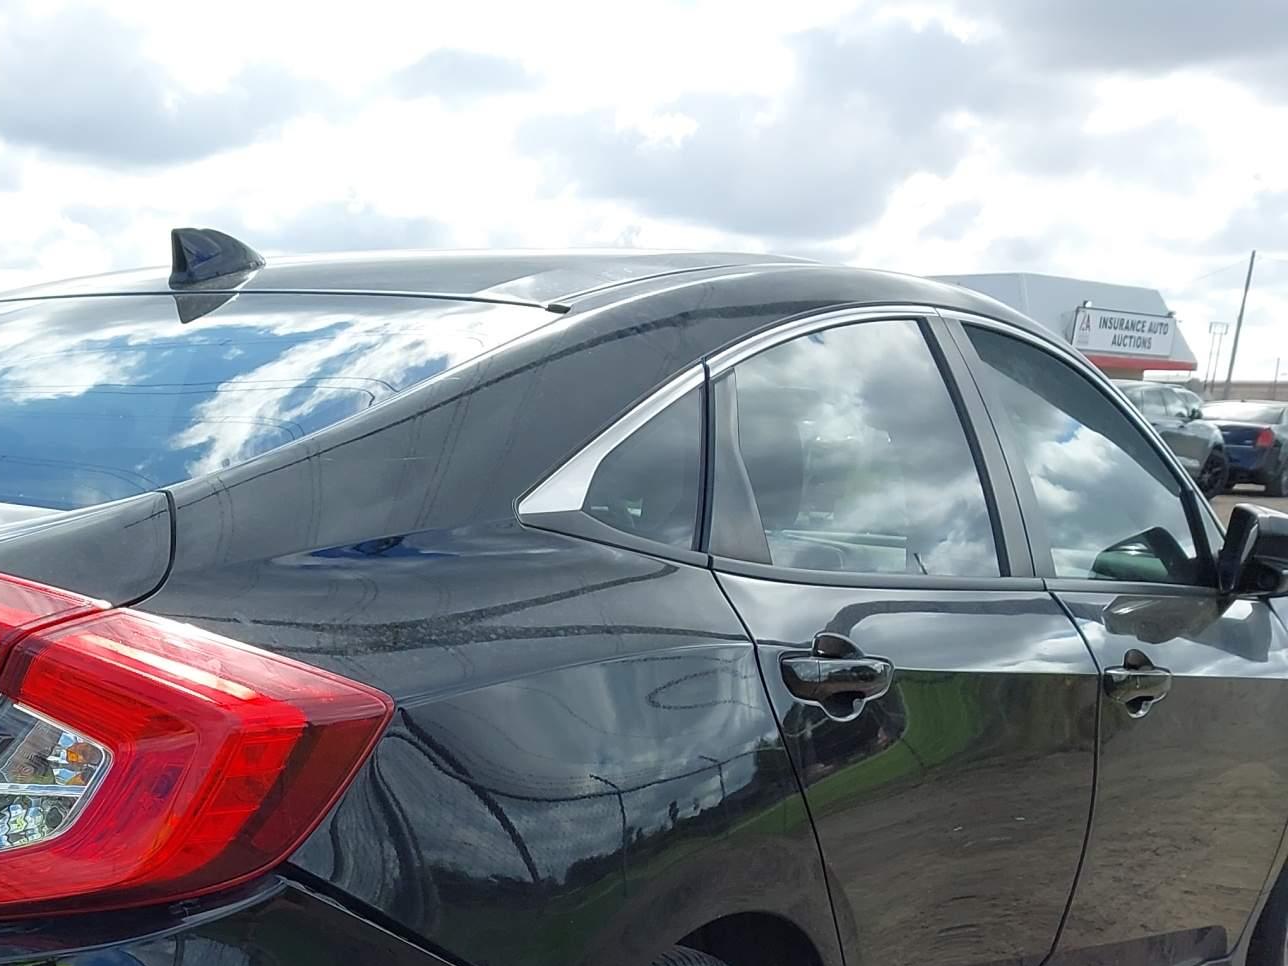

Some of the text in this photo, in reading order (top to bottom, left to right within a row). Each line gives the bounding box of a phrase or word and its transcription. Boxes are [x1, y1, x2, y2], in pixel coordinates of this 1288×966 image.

[1098, 316, 1146, 333] INSURANCE
[1147, 321, 1169, 336] AUTO
[1112, 334, 1152, 350] AUCTIONS
